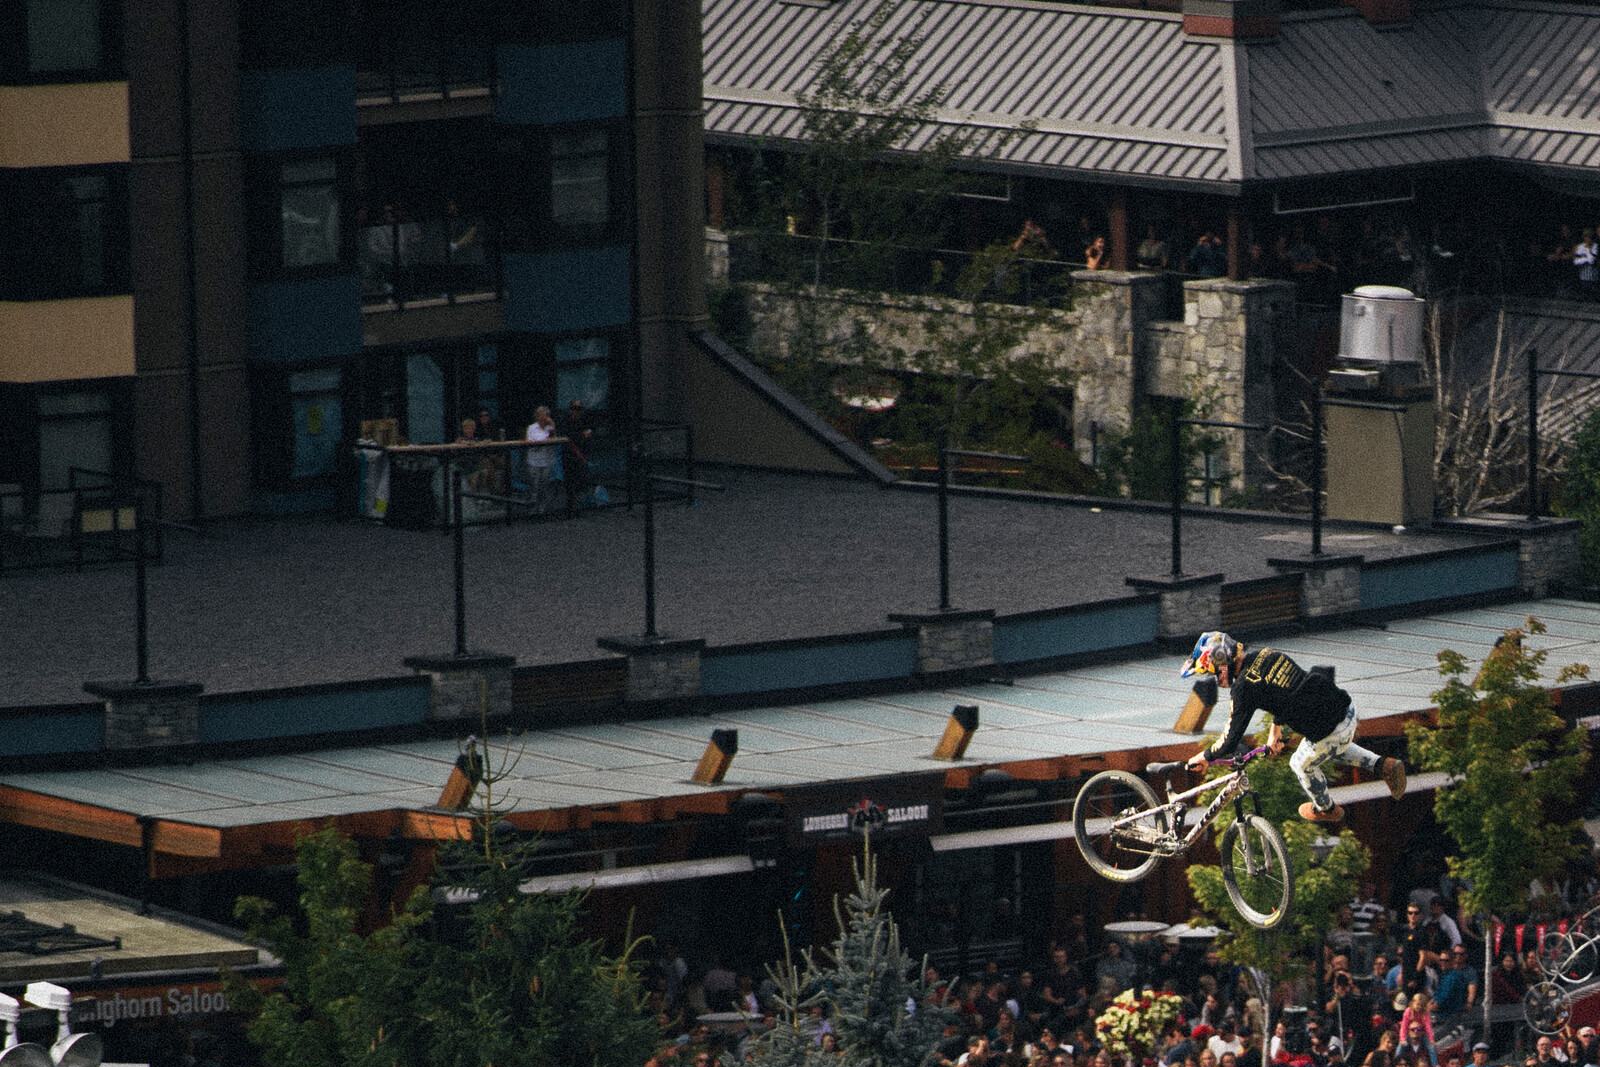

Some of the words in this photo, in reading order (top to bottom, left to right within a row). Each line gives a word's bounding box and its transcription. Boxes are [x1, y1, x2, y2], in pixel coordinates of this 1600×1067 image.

[887, 804, 929, 823] SALOON
[78, 992, 162, 1028] nghorn
[167, 986, 230, 1015] Saloo
